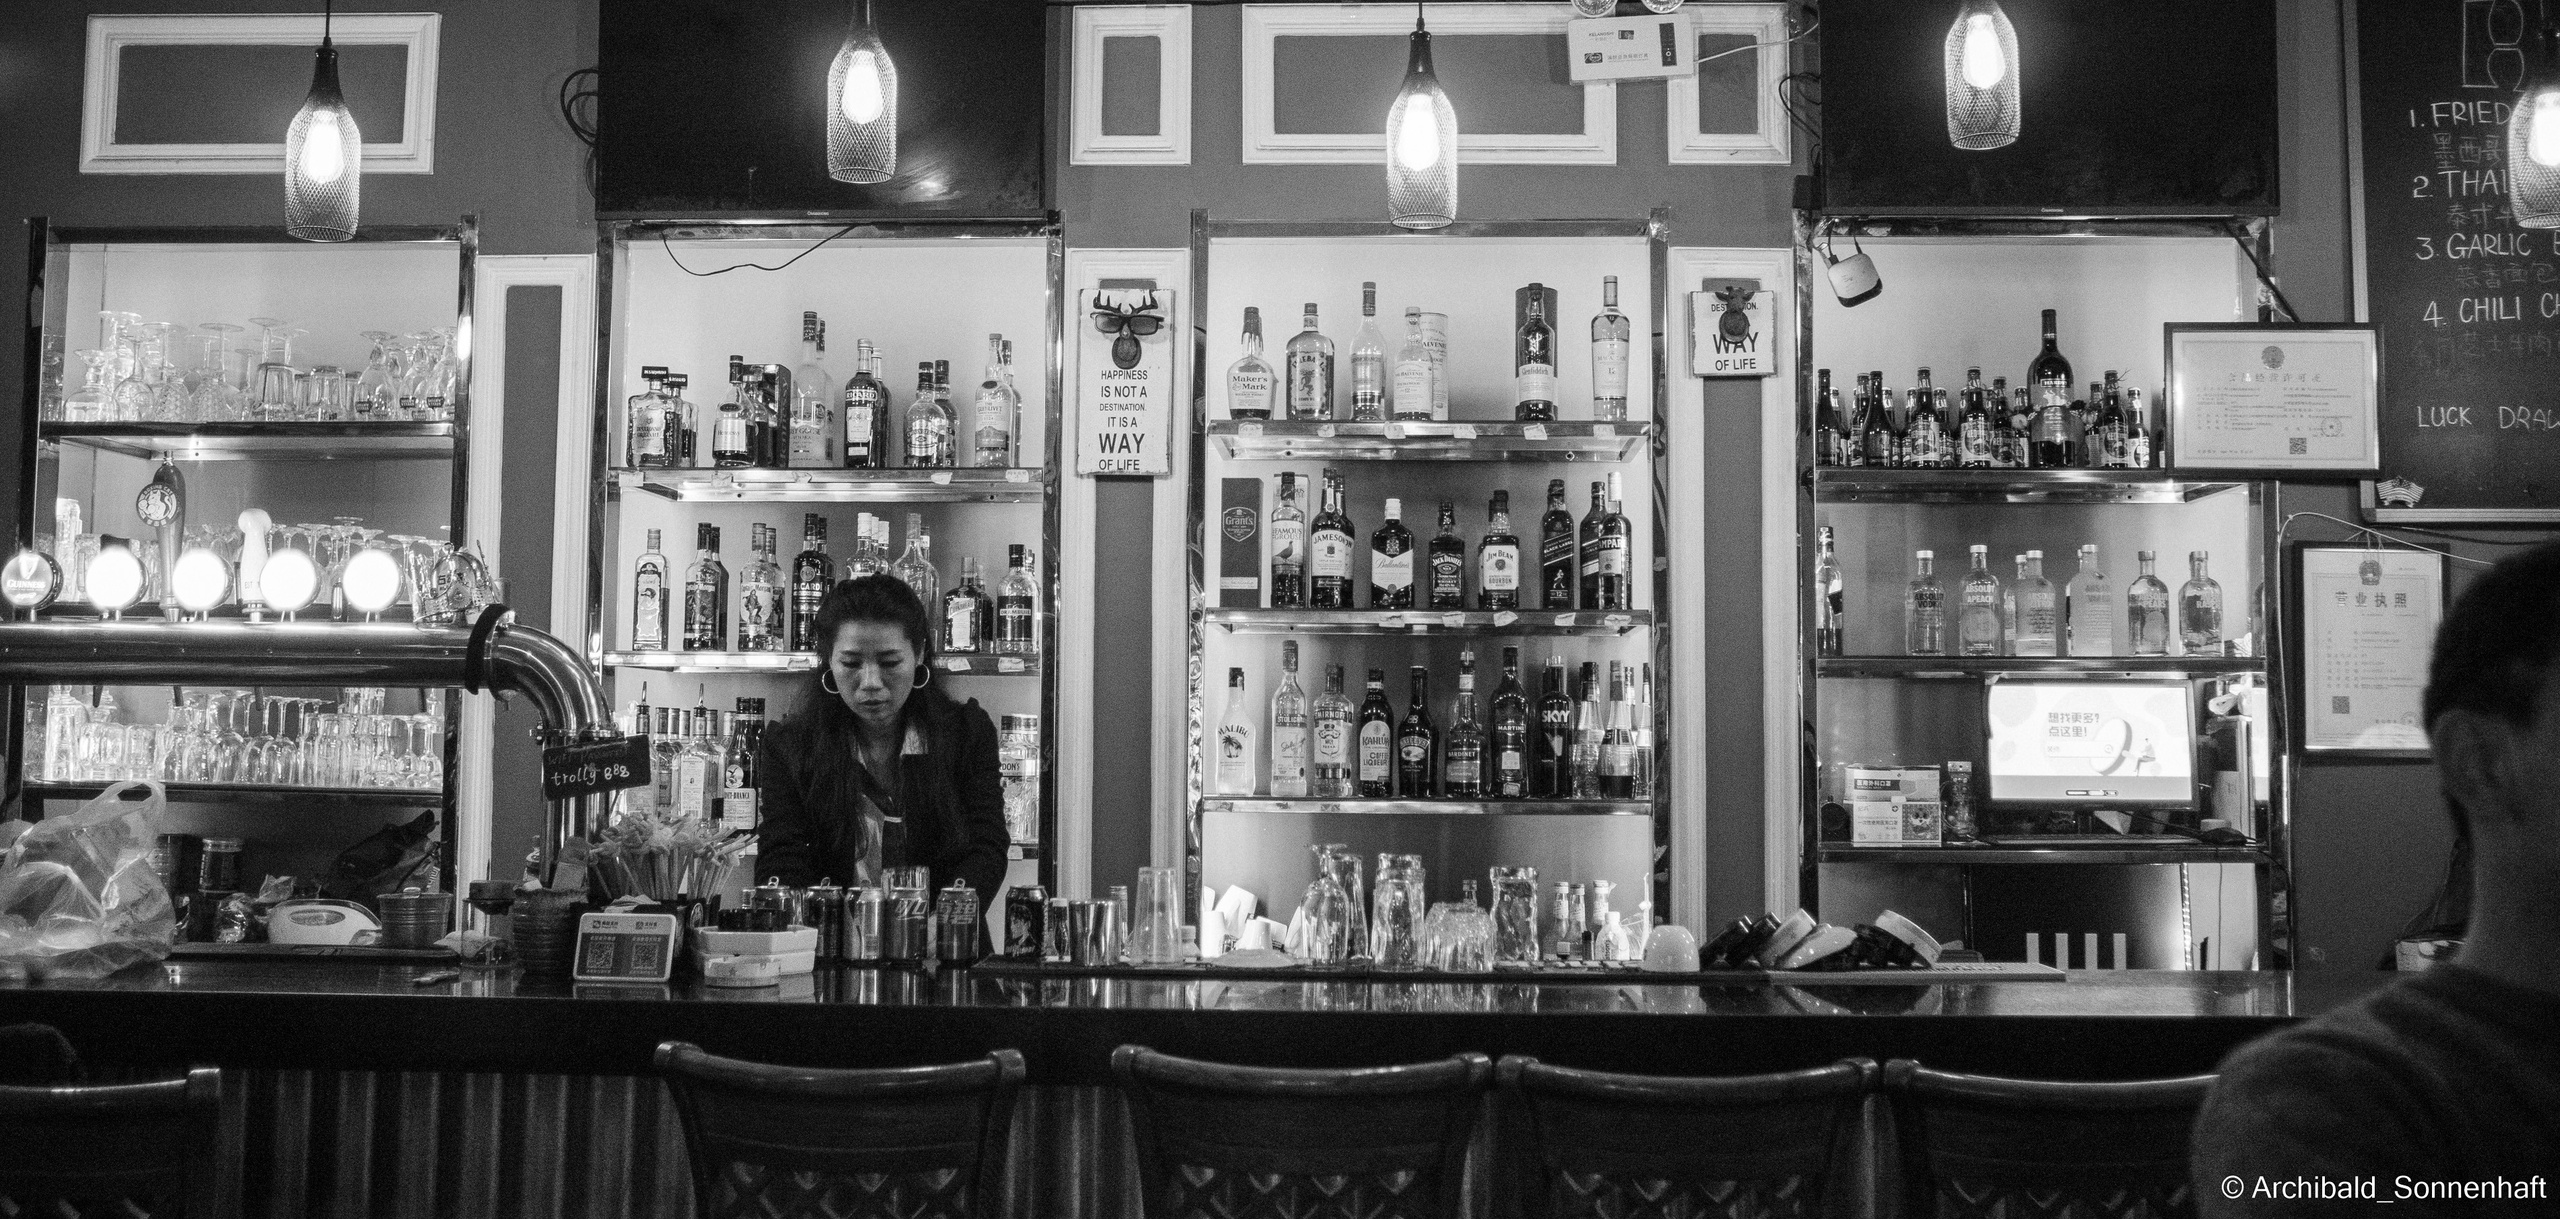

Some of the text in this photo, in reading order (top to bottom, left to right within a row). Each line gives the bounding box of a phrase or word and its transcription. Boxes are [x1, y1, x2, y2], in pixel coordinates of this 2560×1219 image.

[2430, 100, 2512, 127] FRIED
[2438, 169, 2509, 198] THAI
[2446, 232, 2532, 259] GARLIC
[2459, 296, 2521, 323] CHILI
[1712, 332, 1759, 354] WAY
[1715, 358, 1756, 371] OF LIFE
[1100, 370, 1148, 380] HAPPINESS
[1100, 386, 1148, 398] IS NOT A
[1100, 404, 1146, 412] DESTINATION.
[1107, 416, 1138, 428] IT IS A
[2416, 406, 2472, 428] LUCK
[1098, 433, 1146, 454] WAY
[1098, 459, 1140, 470] OF LIFE
[1225, 516, 1254, 526] Grant's
[1486, 550, 1514, 562] JIM BEAM
[6, 579, 46, 588] GUINNESS
[1965, 584, 1996, 593] ABSOLUT
[1556, 590, 1563, 598] 12
[1914, 592, 1944, 600] ABSOLUT
[1966, 595, 1994, 603] APEACH
[2334, 590, 2408, 608] 营业执照
[1542, 710, 1570, 723] SKYY
[1218, 724, 1250, 739] MALIBU
[1002, 762, 1020, 771] DON'S
[551, 764, 630, 786] trolly 888
